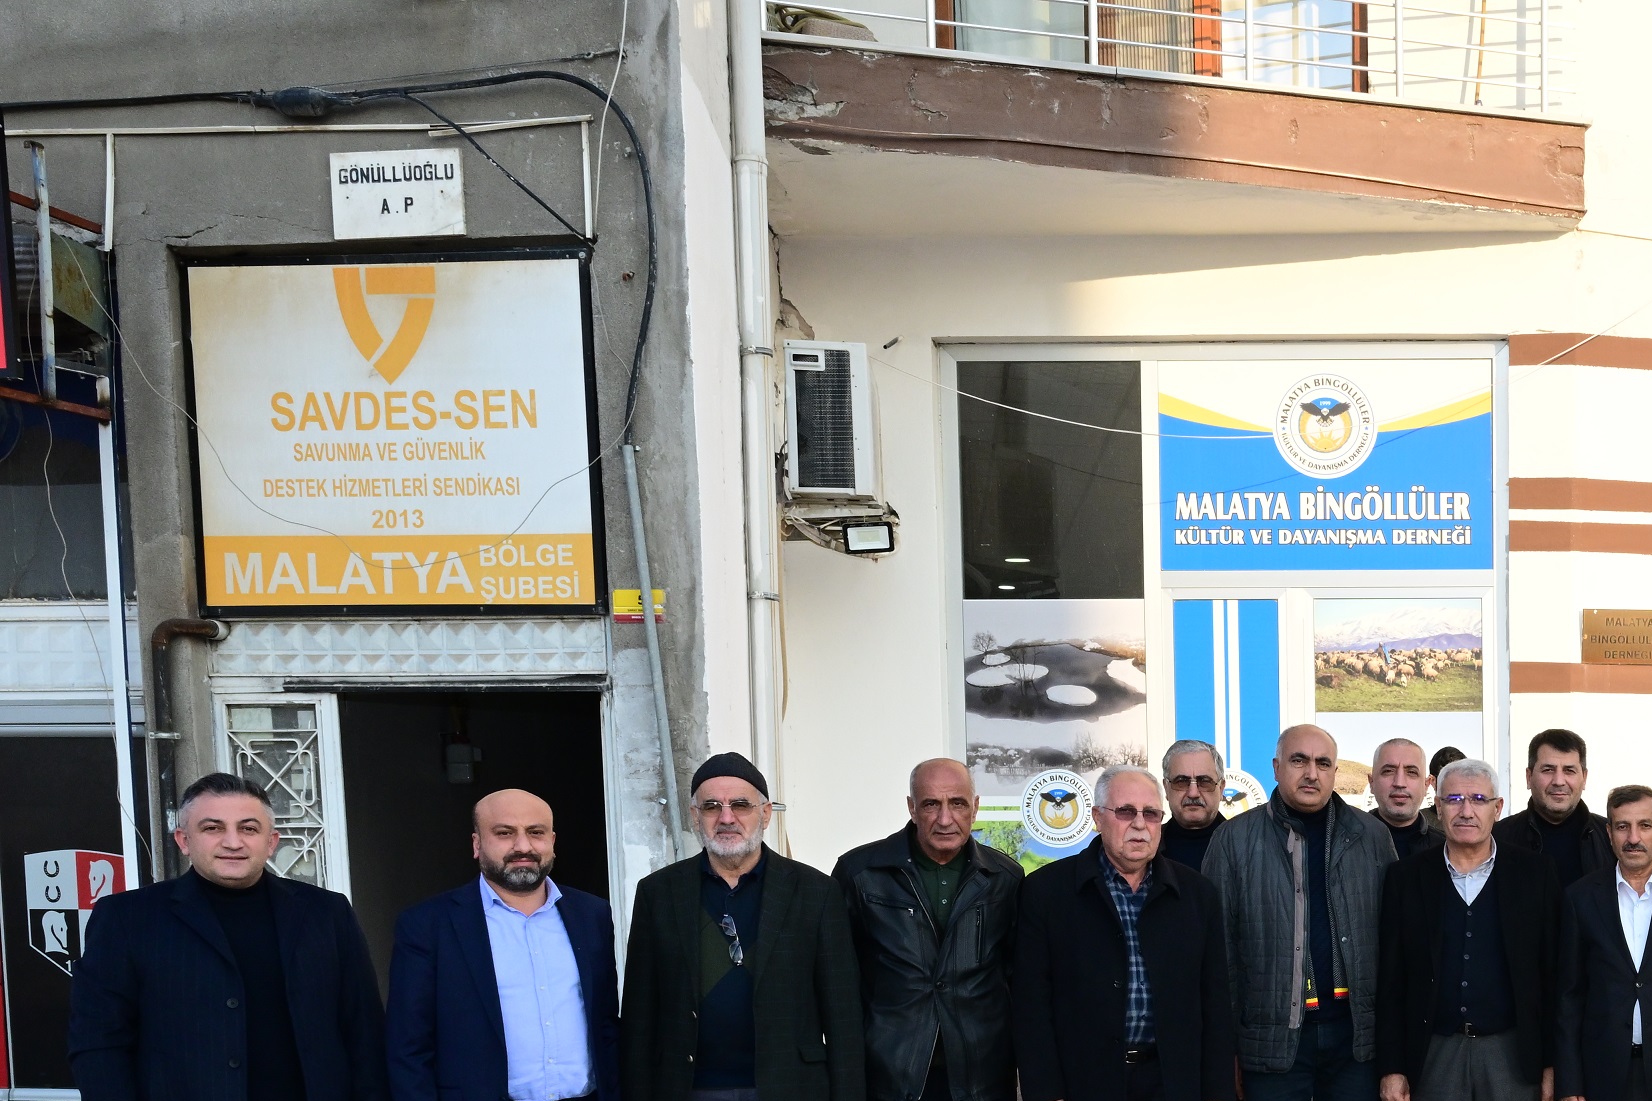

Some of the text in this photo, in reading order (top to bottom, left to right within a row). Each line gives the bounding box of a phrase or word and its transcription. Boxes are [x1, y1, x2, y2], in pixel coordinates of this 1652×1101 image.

[338, 160, 454, 185] GÖNÜLLÜOĞLU
[270, 388, 538, 432] SAVDES-SEN
[1280, 382, 1311, 424] MALATYA
[293, 437, 486, 462] SAVUNMA VE GÜVENLİK
[263, 472, 521, 498] DESTEK HİZMETLERİ SENDİKASI
[1174, 485, 1471, 521] MALATYA BİNGÖLLÜLER
[371, 509, 425, 530] 2013
[1174, 525, 1472, 549] KÜLTÜR VE DAYANIŞMA DERNEĞİ
[479, 539, 574, 568] BÖLGE
[223, 550, 475, 595] MALATYA
[480, 570, 580, 604] ŞUBESİ
[1025, 778, 1048, 808] MALATYA
